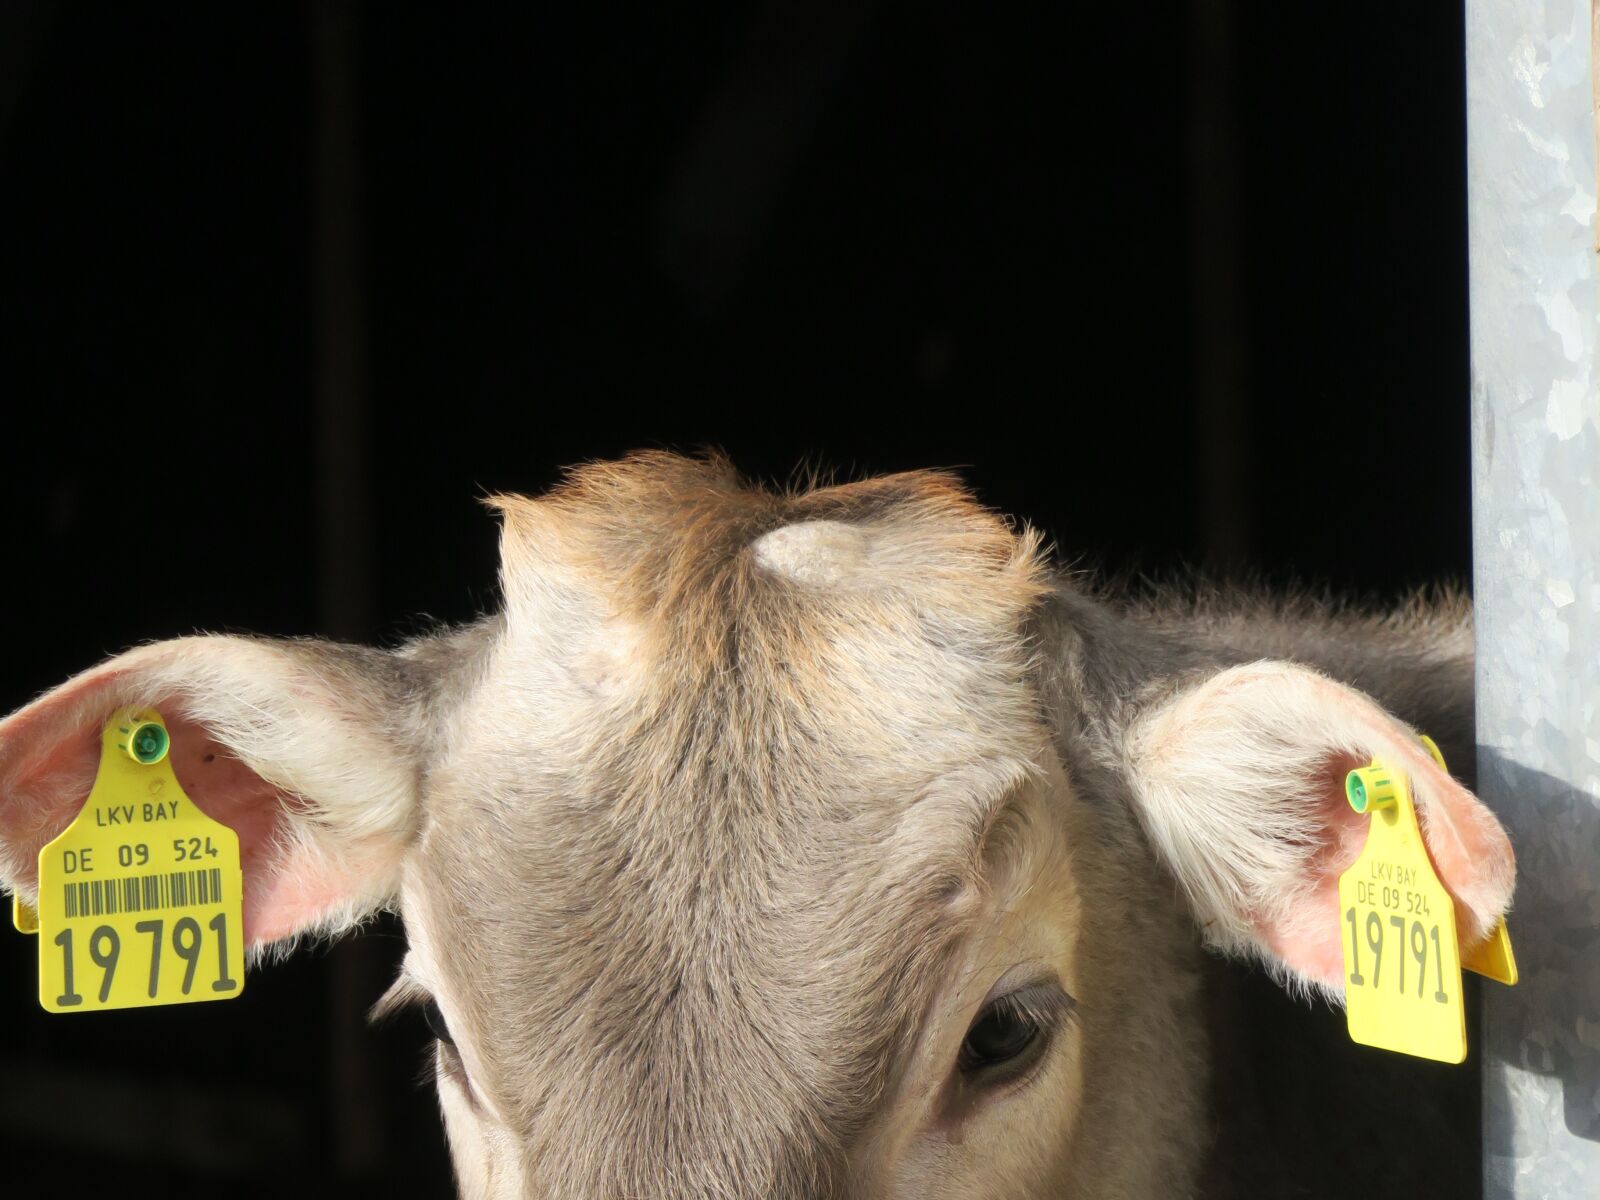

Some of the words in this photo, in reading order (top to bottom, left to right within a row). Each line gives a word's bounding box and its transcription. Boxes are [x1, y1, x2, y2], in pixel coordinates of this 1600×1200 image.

[96, 803, 134, 827] LKV
[143, 800, 179, 822] BAY
[64, 848, 93, 874] DE
[118, 843, 149, 867] 09
[173, 837, 218, 862] 524
[1371, 861, 1393, 881] LKV
[1397, 865, 1416, 886] BAY
[1357, 880, 1375, 906] DE
[1382, 886, 1400, 909] 09
[1406, 892, 1430, 917] 524
[1346, 906, 1448, 1004] 19791
